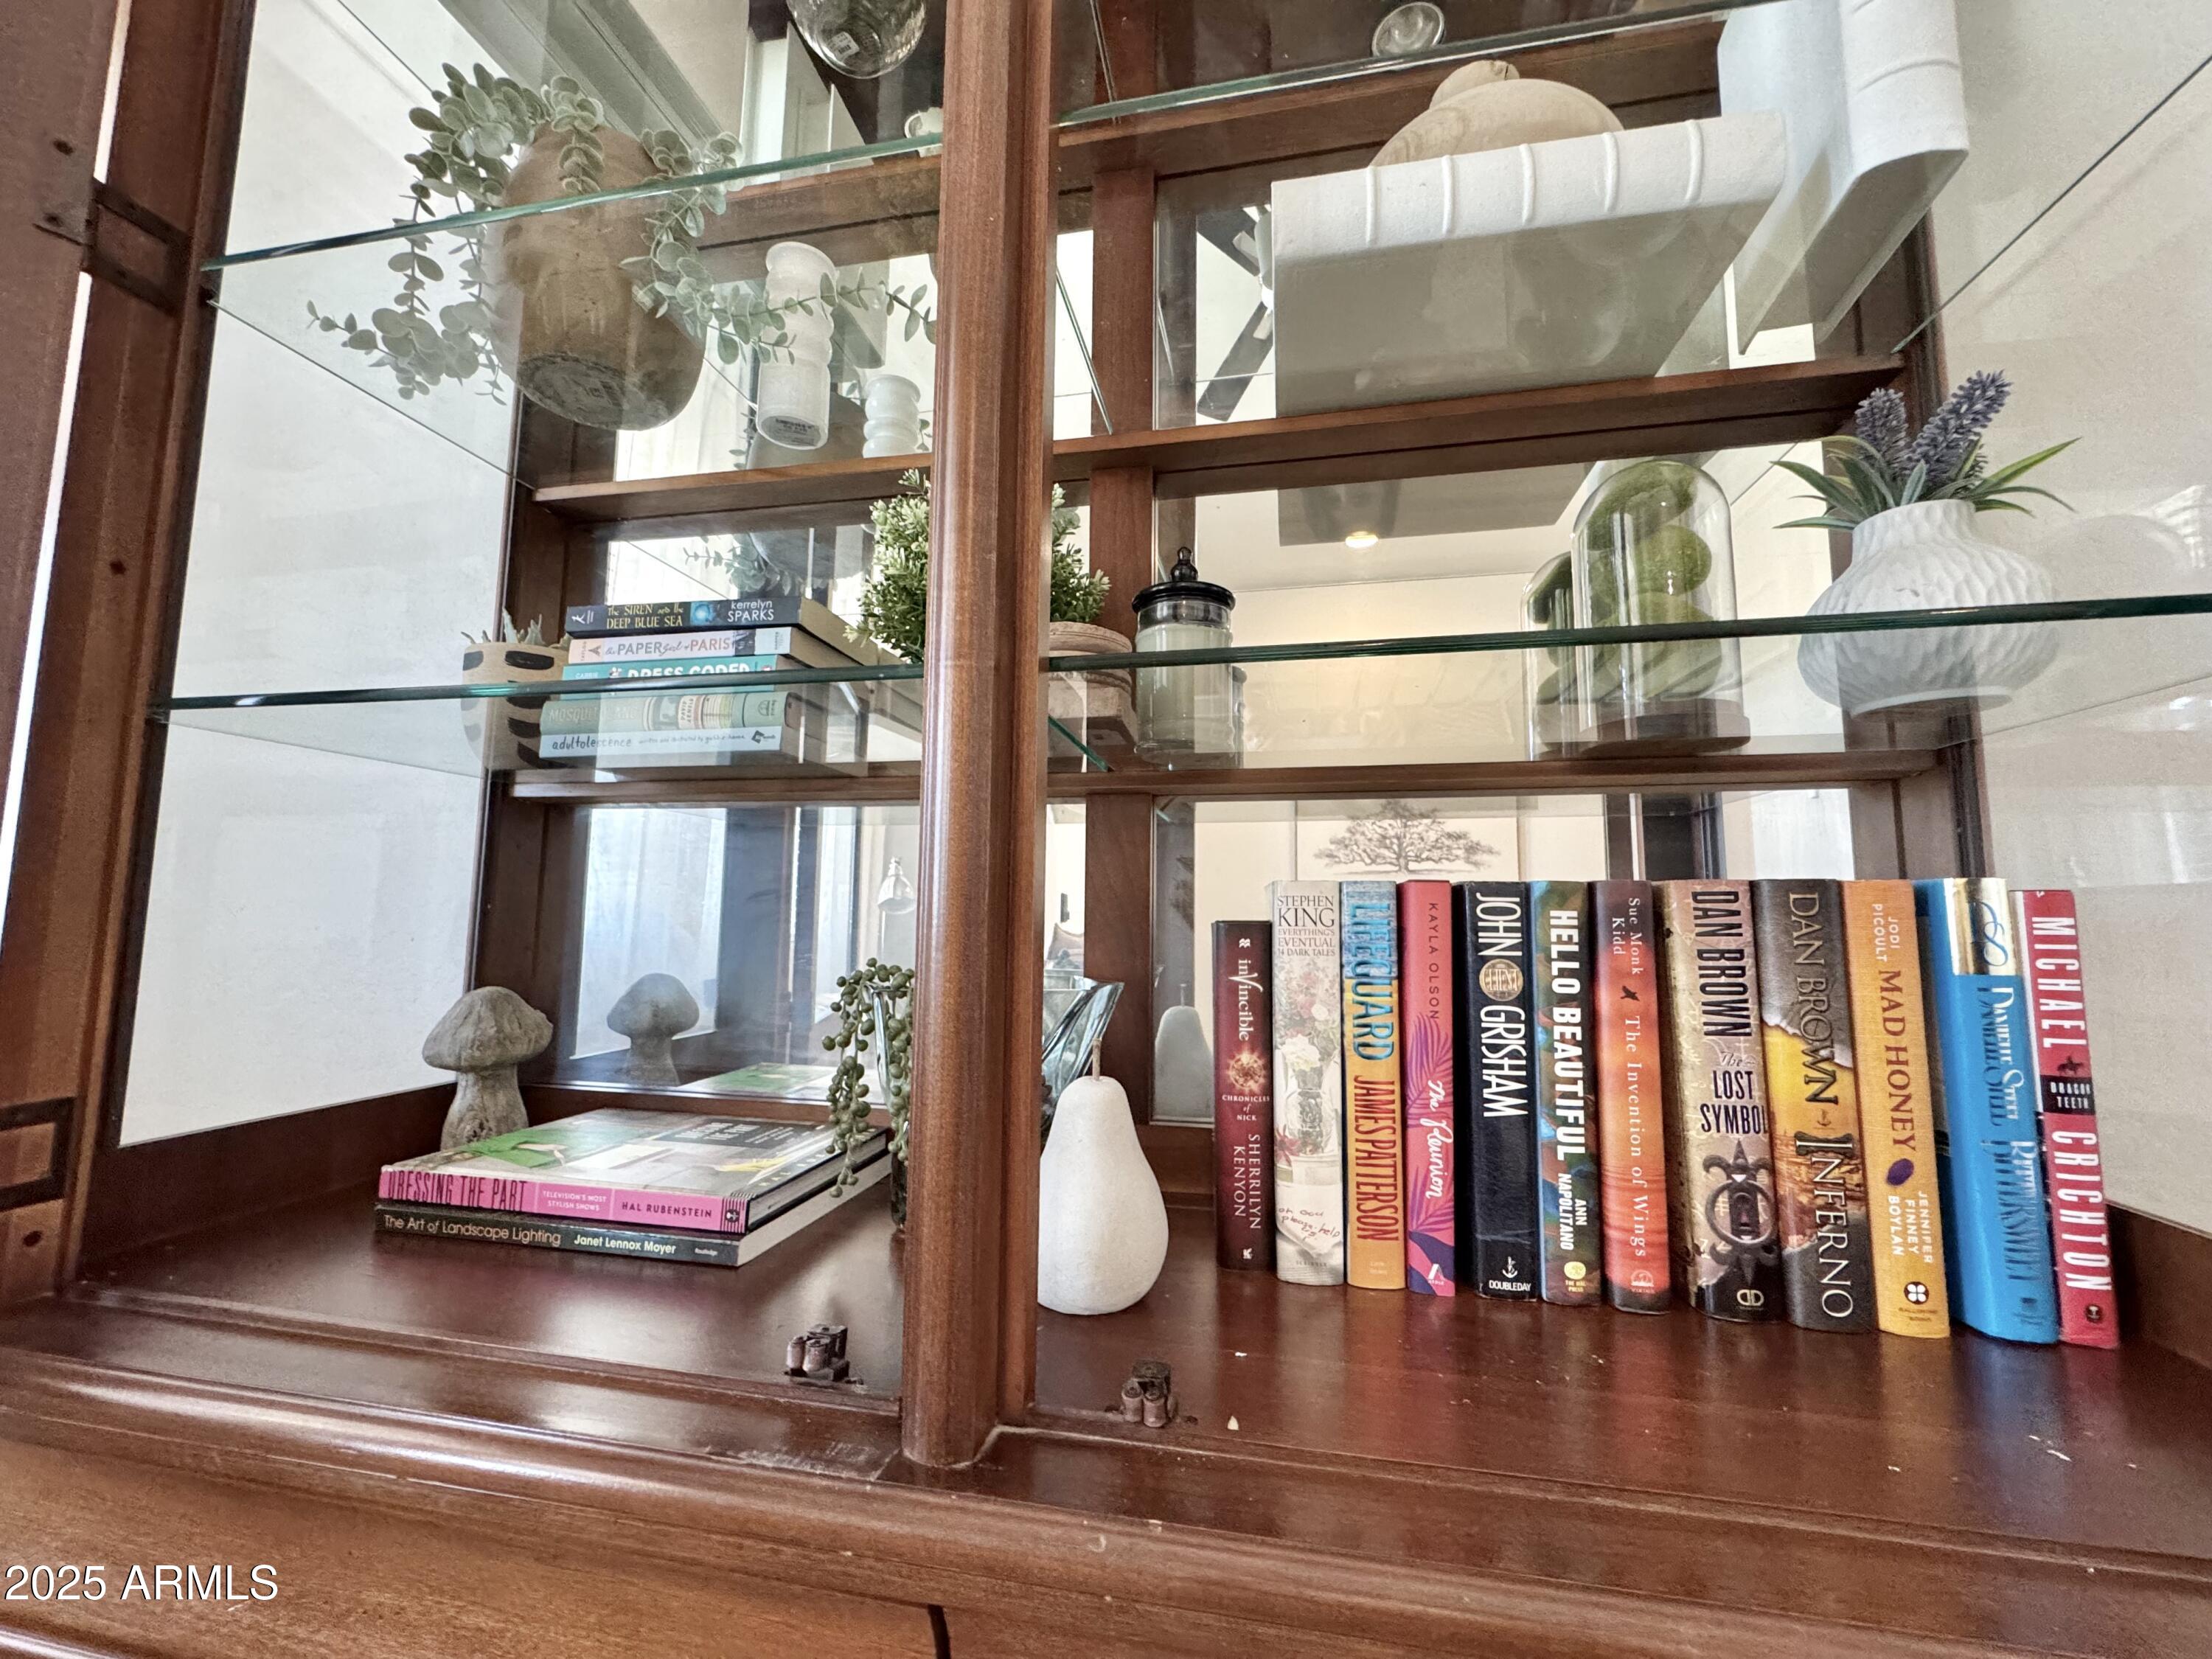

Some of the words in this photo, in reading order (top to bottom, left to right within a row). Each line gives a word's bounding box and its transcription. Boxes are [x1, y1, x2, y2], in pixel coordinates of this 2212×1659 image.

[607, 617, 630, 630] DEEP
[635, 616, 659, 628] BLUE
[664, 615, 683, 627] SEA
[624, 603, 653, 616] SIREN
[727, 609, 774, 622] SPARKS
[731, 600, 773, 611] kerrelyn
[617, 641, 662, 655] PAPER
[690, 637, 731, 652] PARIS
[1277, 895, 1334, 907] STEPHEN
[1277, 907, 1335, 928] KING
[1628, 897, 1641, 925] Sue
[1691, 890, 1744, 938] DAN
[1278, 937, 1336, 948] EVENTUAL
[1428, 902, 1440, 956] KAYLA
[1476, 892, 1523, 957] JOHN
[1612, 917, 1627, 956] Kidd
[1789, 891, 1823, 967] DAN
[1871, 903, 1888, 962] PICOULT
[1888, 917, 1900, 950] JODI
[1287, 948, 1310, 956] DARK
[1311, 948, 1336, 956] TALES
[1548, 910, 1582, 995] HELLO
[1630, 931, 1644, 975] Monk
[1350, 903, 1394, 1060] LIFEGUARD
[1428, 961, 1441, 1020] OLSON
[1697, 948, 1753, 1038] BROWN
[1878, 970, 1906, 1037] MAD
[2031, 917, 2087, 1048] MICHAEL
[1624, 1015, 1641, 1053] The
[1795, 975, 1840, 1106] BROWN
[1480, 1005, 1528, 1119] GRISHAM
[1552, 1006, 1587, 1162] BEAUTIFUL
[1713, 1070, 1753, 1099] LOST
[1222, 1094, 1270, 1102] CHRONICLES
[1353, 1075, 1397, 1135] JAMES
[1427, 1079, 1446, 1112] The
[1627, 1062, 1646, 1157] Invention
[1885, 1044, 1916, 1152] HONEY
[2056, 1096, 2089, 1109] TEETH
[1700, 1103, 1769, 1135] SYMBOL
[1234, 1146, 1246, 1217] KENYON
[1248, 1134, 1262, 1229] SHERRILYN
[1420, 1118, 1454, 1199] Reunion
[1631, 1166, 1648, 1188] of
[387, 1171, 454, 1206] DRESSING
[460, 1175, 488, 1208] THE
[492, 1178, 527, 1211] PART
[542, 1190, 586, 1202] TELEVISION'S
[588, 1194, 607, 1203] MOST
[548, 1200, 575, 1209] STYLISH
[575, 1203, 600, 1211] SHOWS
[622, 1202, 641, 1211] HAL
[646, 1203, 712, 1218] RUBENSTEIN
[1355, 1138, 1399, 1241] PATTERSON
[1558, 1173, 1575, 1251] NAPOLITANO
[1575, 1198, 1587, 1226] ANN
[2052, 1130, 2113, 1293] CRICHTON
[384, 1214, 405, 1229] The
[406, 1217, 425, 1231] Art
[427, 1220, 440, 1234] of
[442, 1219, 509, 1239] Landscape
[512, 1226, 561, 1247] Lighting
[574, 1234, 603, 1247] Janet
[605, 1236, 641, 1251] Lennox
[644, 1239, 676, 1255] Moyer
[1630, 1194, 1649, 1258] Wings
[1795, 1130, 1854, 1318] INFERNO
[1888, 1195, 1905, 1256] BOYLAN
[1905, 1199, 1920, 1254] FINNEY
[1919, 1191, 1934, 1263] JENNIFER
[1489, 1280, 1531, 1292] DOUBLEDAY
